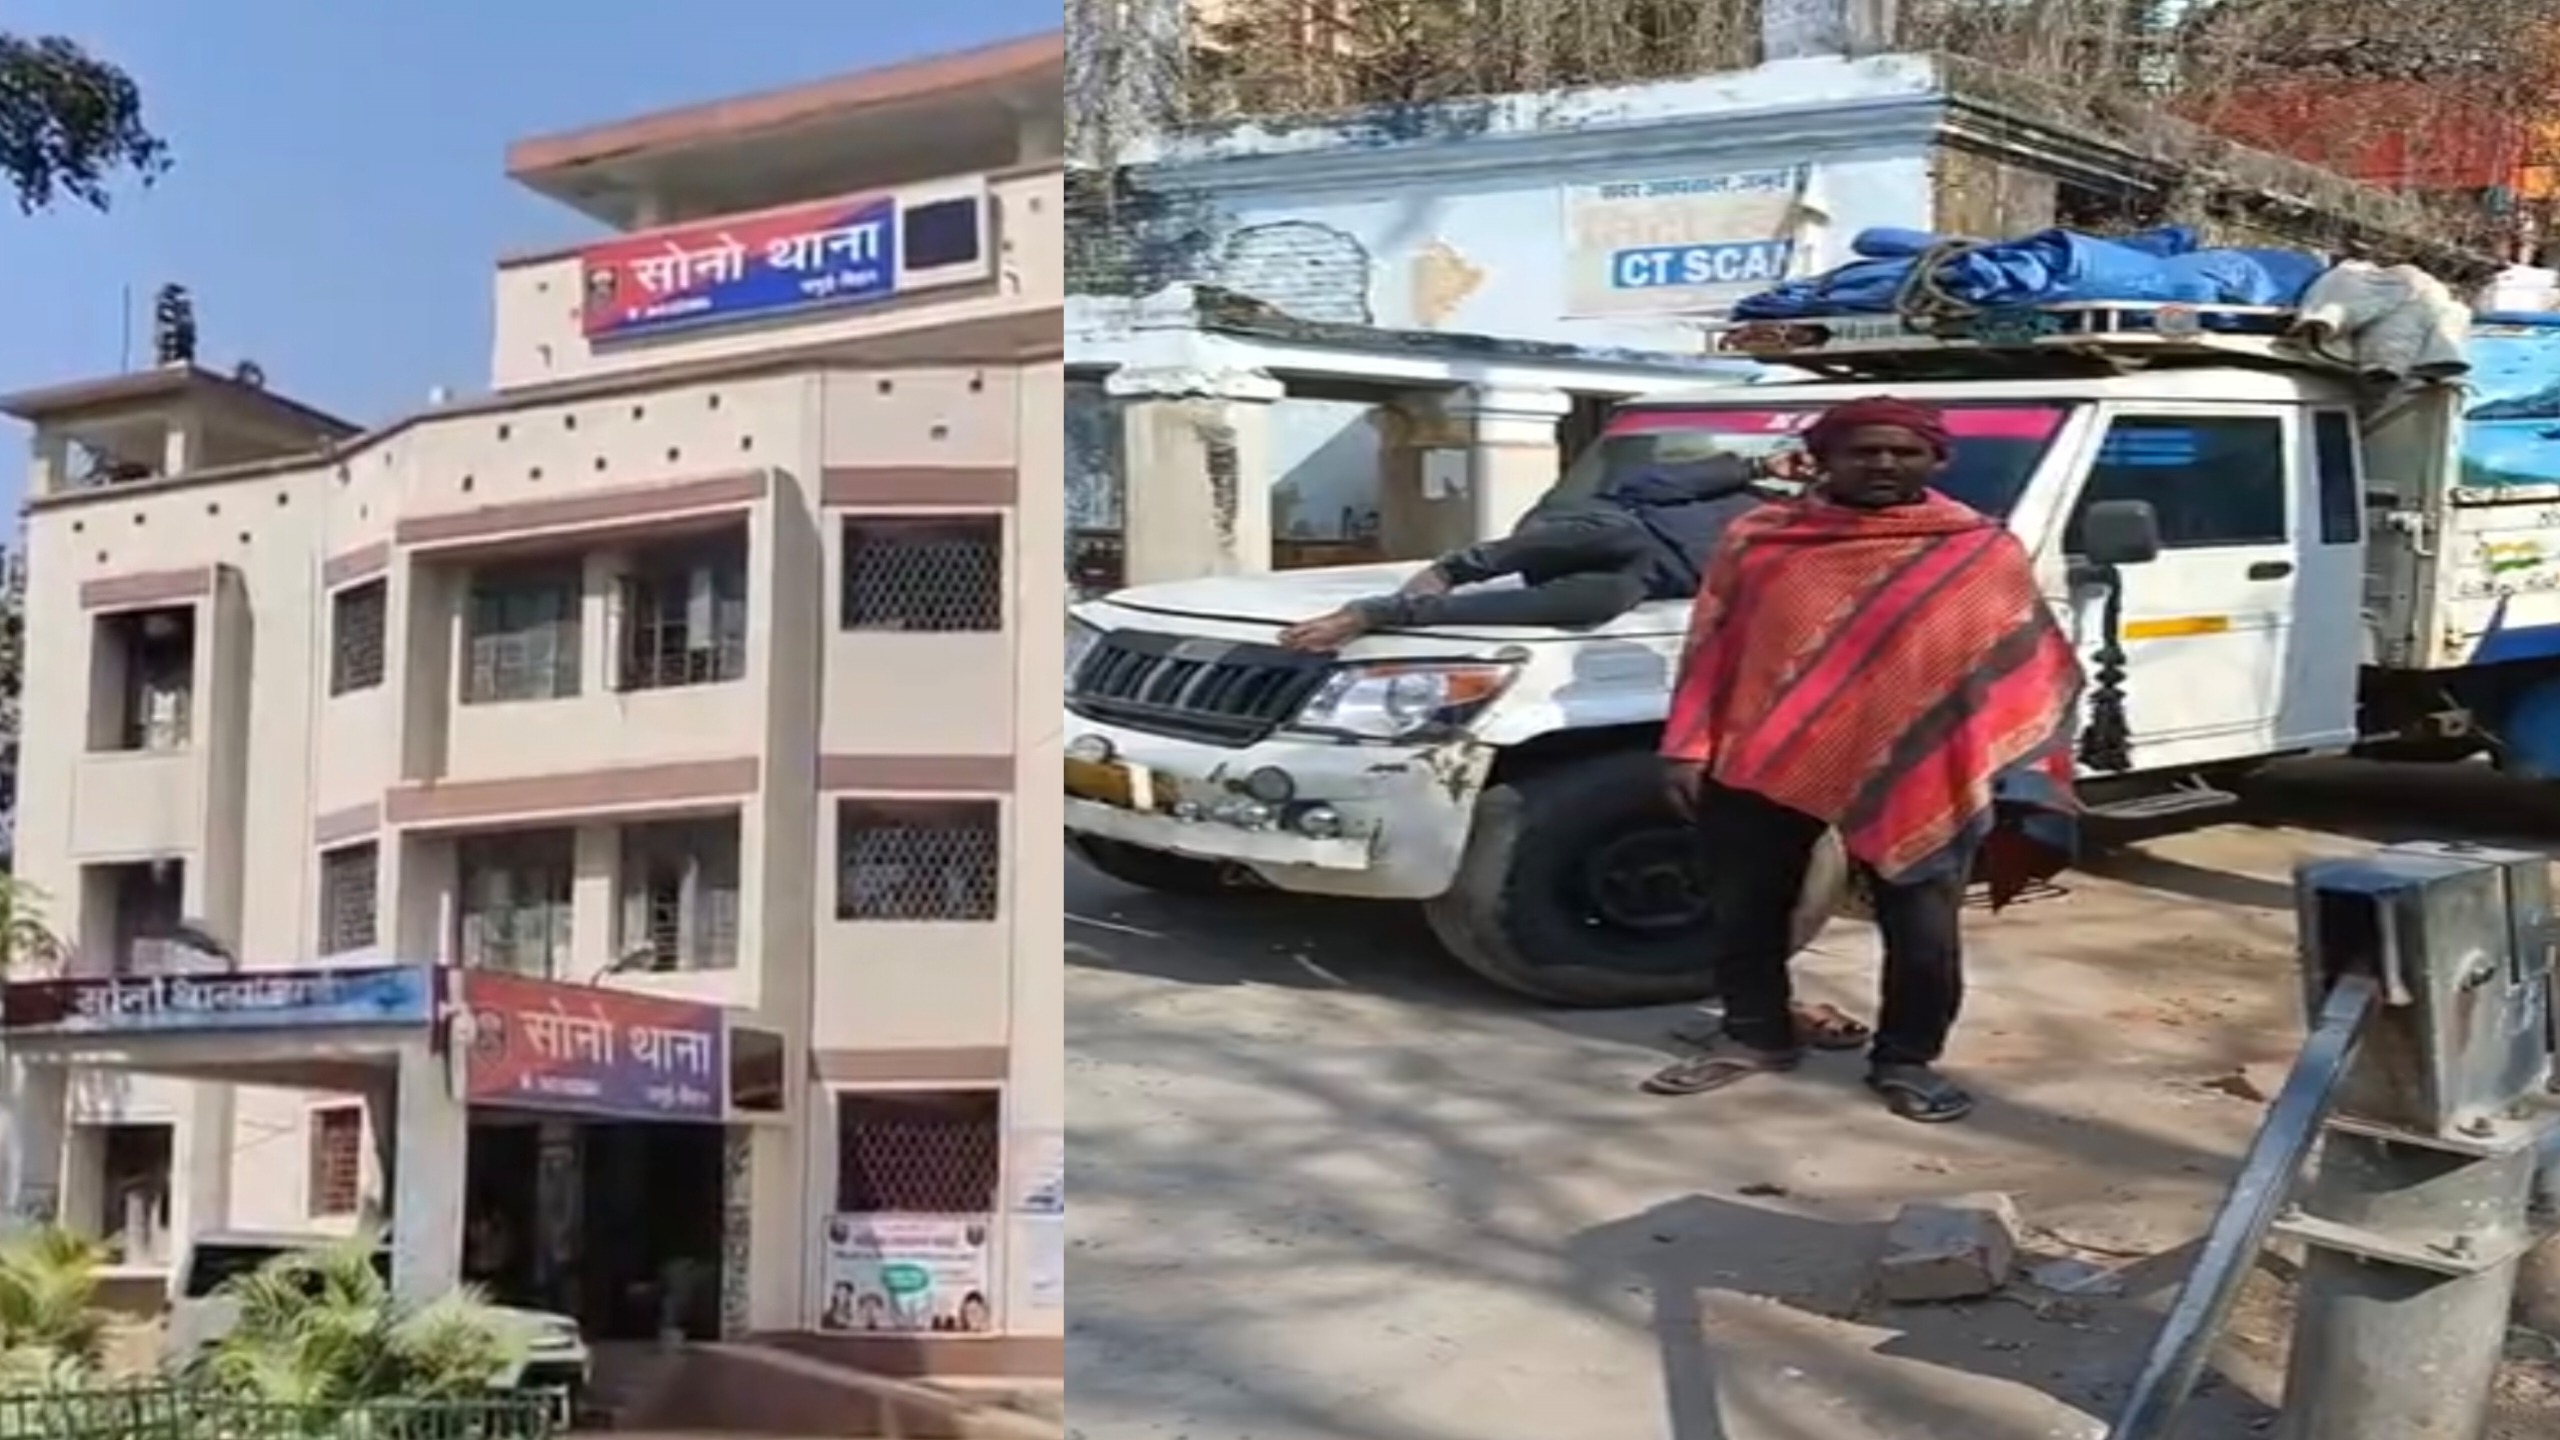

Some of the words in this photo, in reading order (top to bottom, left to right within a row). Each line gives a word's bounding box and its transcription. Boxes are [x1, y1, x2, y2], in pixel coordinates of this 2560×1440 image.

[629, 233, 747, 294] सोनो
[767, 222, 883, 272] थाना
[1622, 252, 1673, 285] CT
[516, 999, 614, 1064] सोनो
[628, 1024, 712, 1077] थाना
